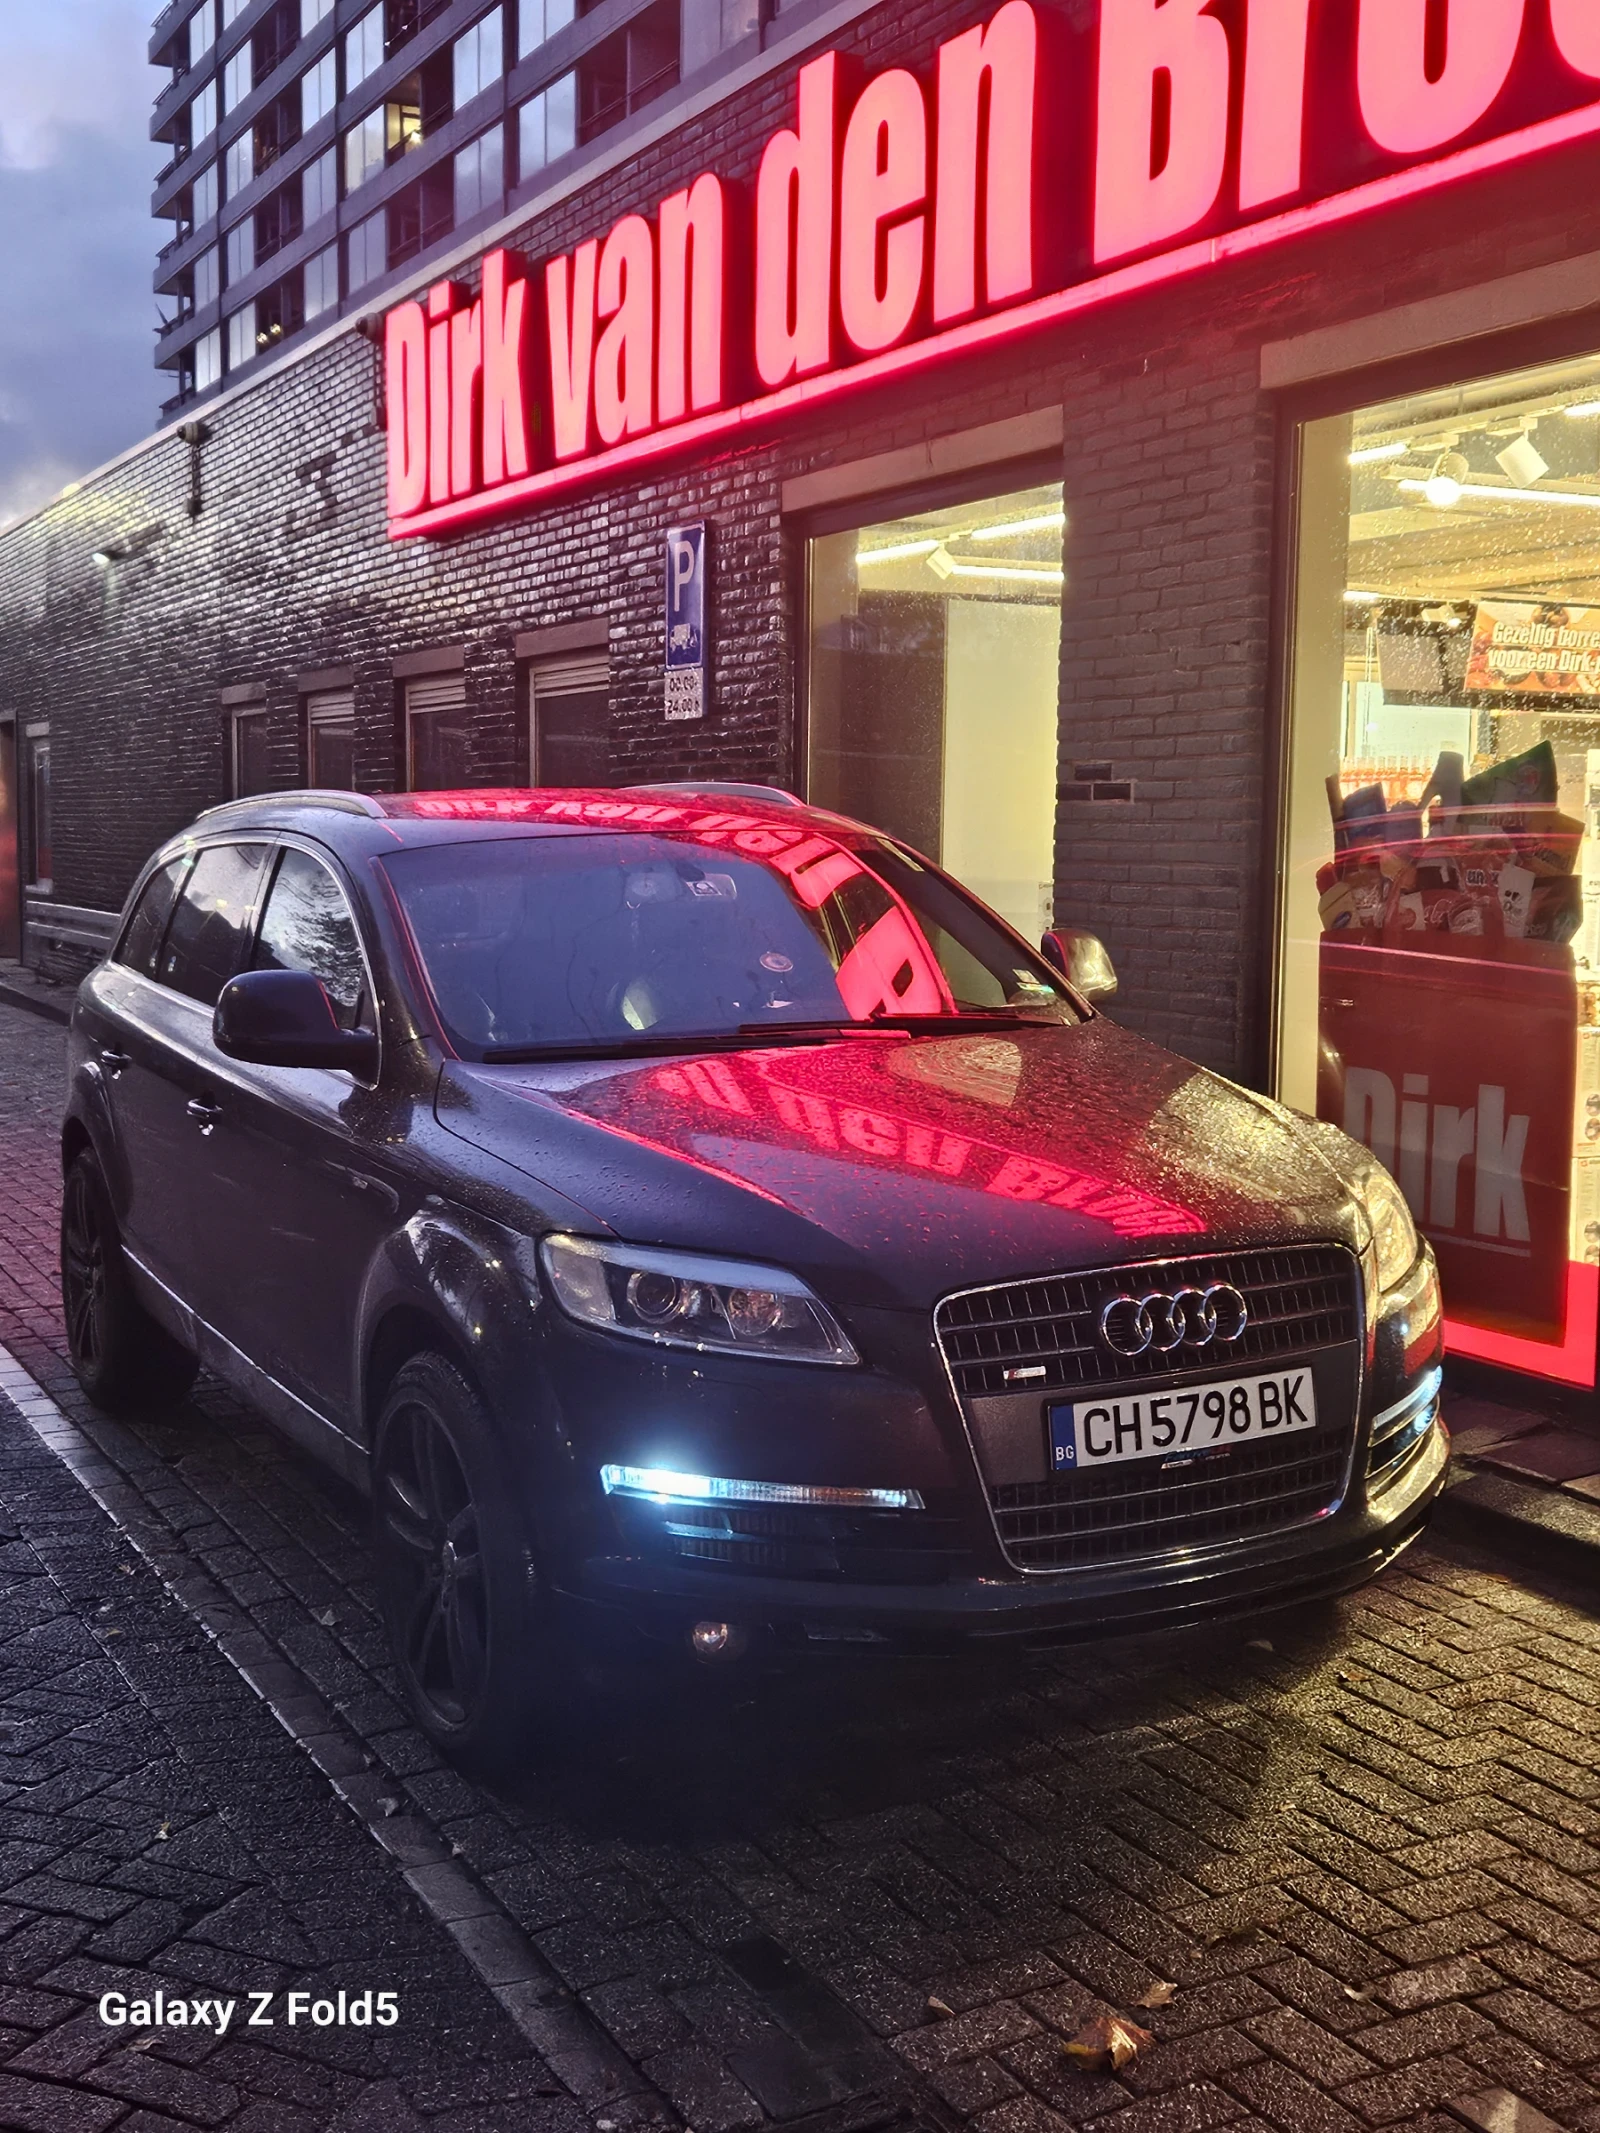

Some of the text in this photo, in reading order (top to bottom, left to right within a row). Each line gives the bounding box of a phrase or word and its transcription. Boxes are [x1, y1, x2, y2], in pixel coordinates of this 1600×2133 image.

[386, 0, 1600, 518] Dirk van den Br
[674, 540, 695, 612] P
[1492, 620, 1556, 649] Gezellig
[1487, 649, 1600, 675] voor een Dirk-
[1344, 1066, 1532, 1242] Dirk
[1055, 1445, 1075, 1461] BG
